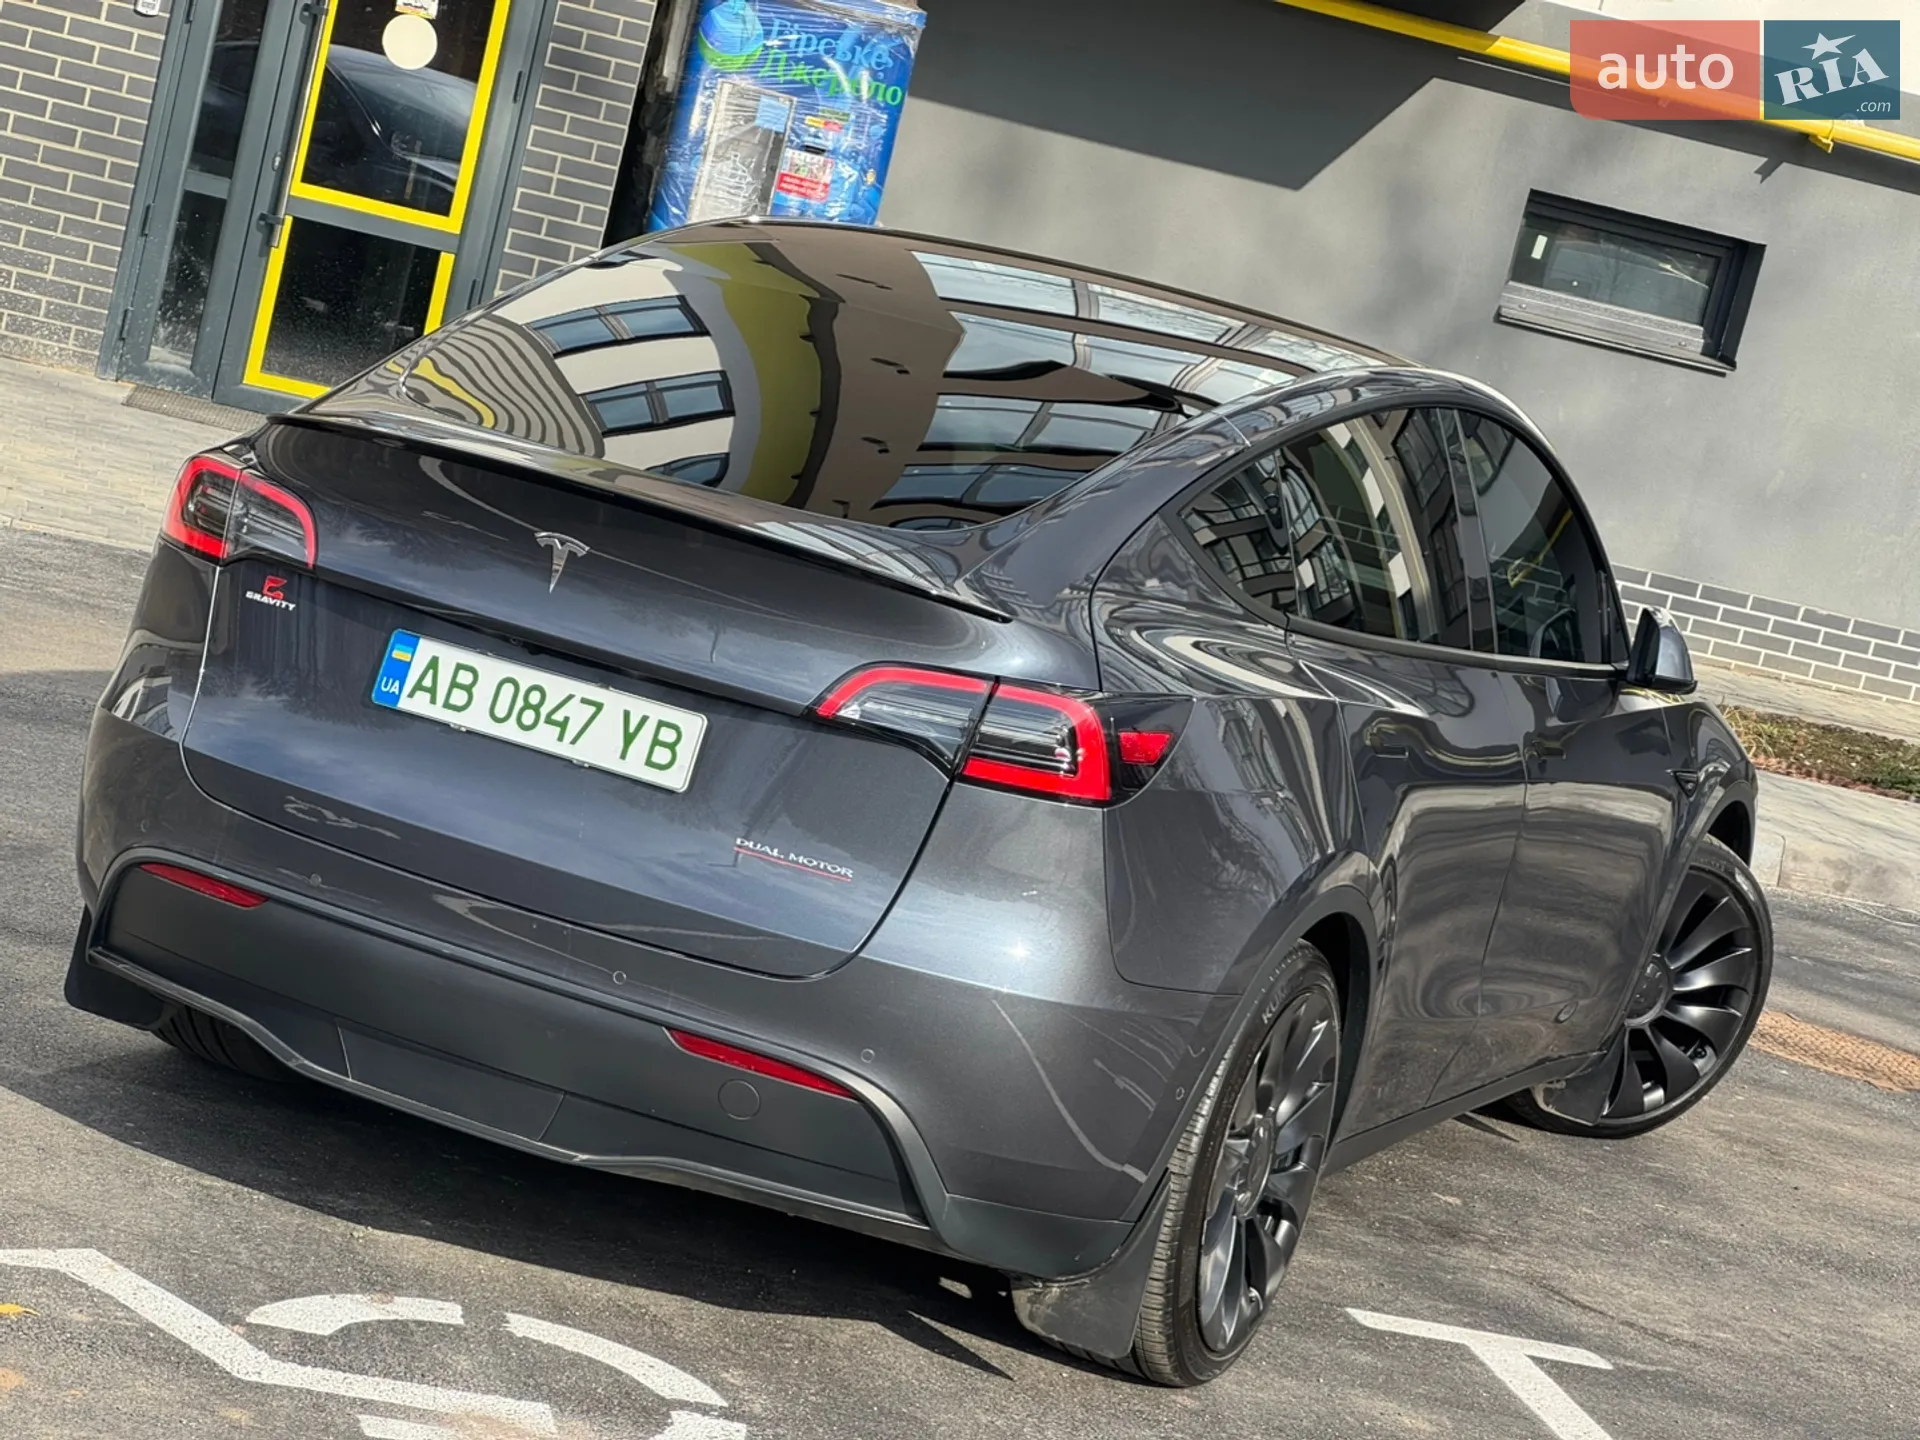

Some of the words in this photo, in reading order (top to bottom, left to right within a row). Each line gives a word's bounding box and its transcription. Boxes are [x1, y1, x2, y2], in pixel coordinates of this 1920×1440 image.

[245, 590, 296, 611] GRAVITY
[380, 676, 400, 696] UA
[407, 655, 479, 713] AB
[489, 676, 605, 745] 0847
[616, 709, 683, 771] YB
[735, 837, 783, 858] DUAL
[788, 852, 854, 878] MOTOR
